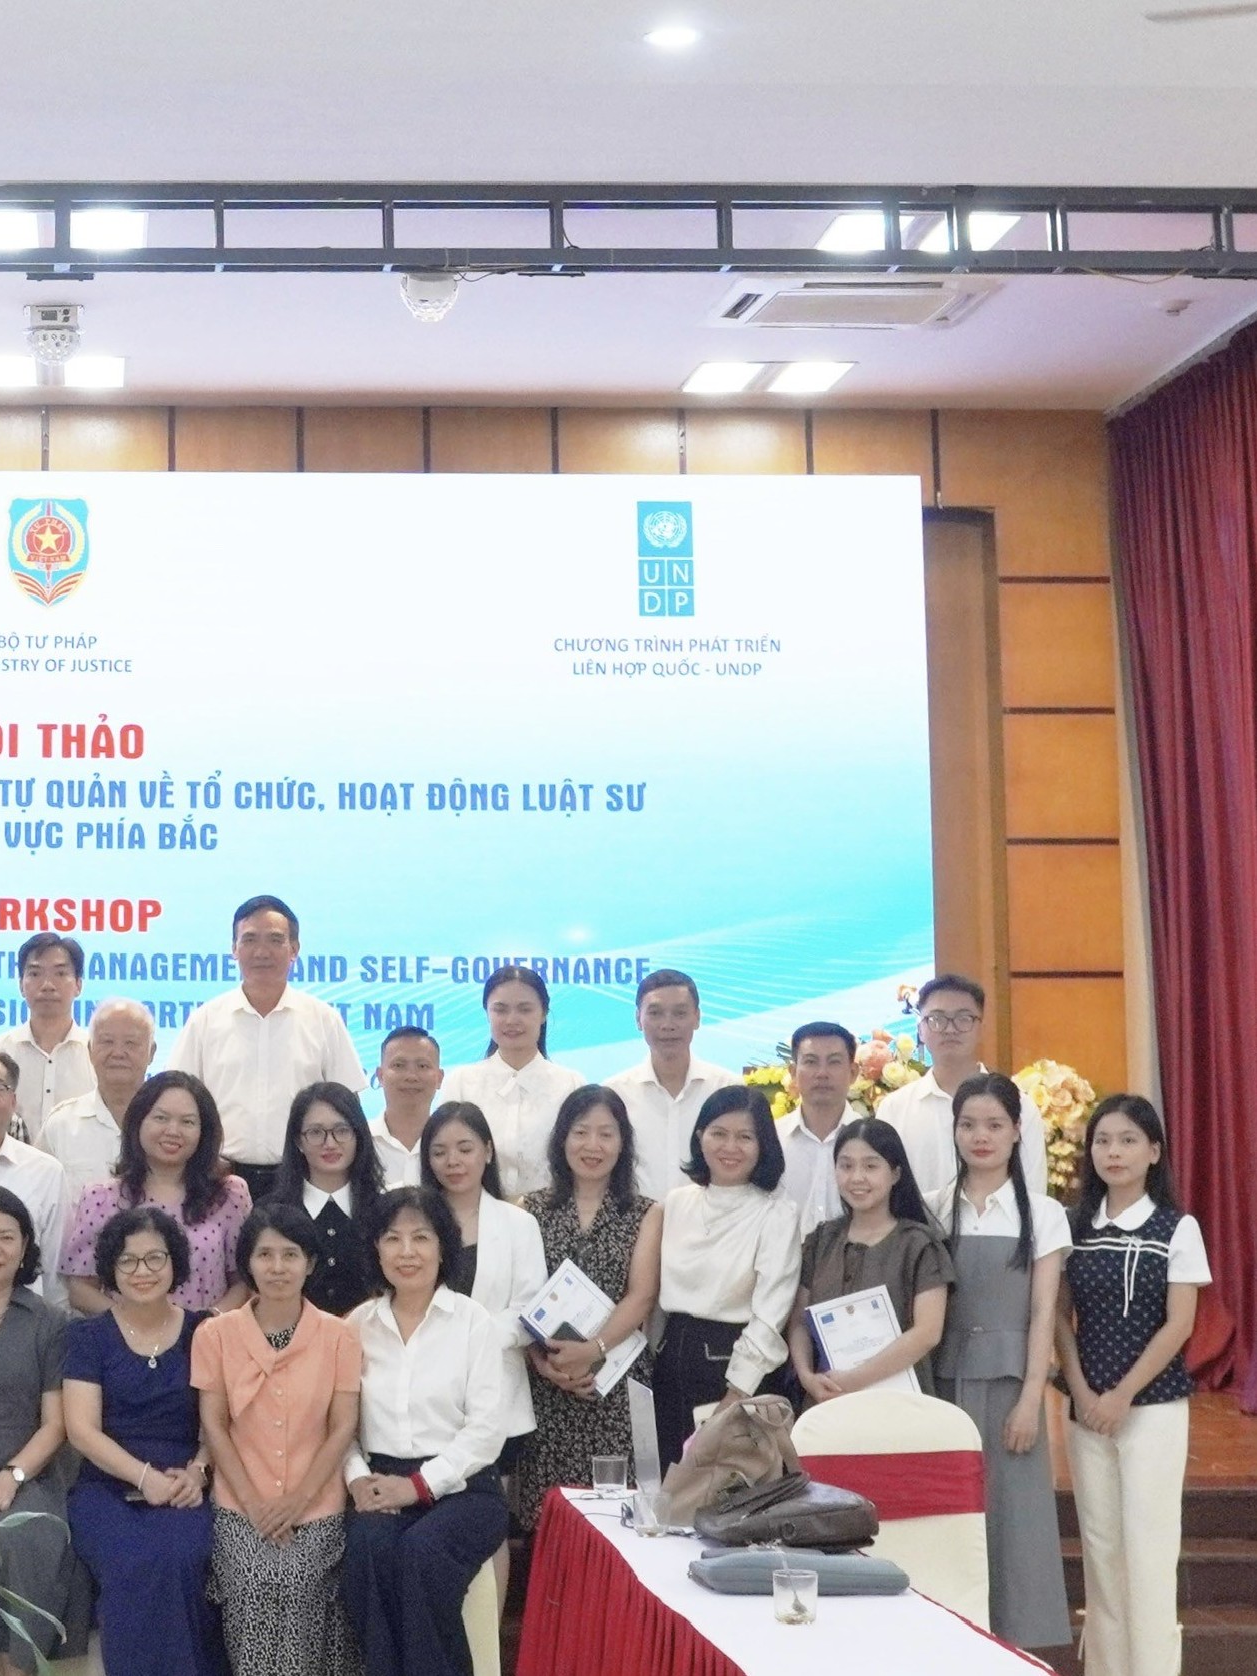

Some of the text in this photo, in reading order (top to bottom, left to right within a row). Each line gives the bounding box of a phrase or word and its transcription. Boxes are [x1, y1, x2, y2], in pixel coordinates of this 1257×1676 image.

[643, 563, 689, 583] UN
[644, 592, 689, 613] DP
[25, 634, 49, 649] TƯ
[54, 632, 98, 650] PHÁP
[553, 633, 781, 653] CHƯƠNG TRÌNH PHÁT TRIỂN
[45, 659, 66, 673] OF
[70, 659, 133, 673] JUSTICE
[573, 658, 607, 676] LIÊN
[613, 661, 647, 678] HỢP
[652, 657, 700, 678] QUỐC
[715, 662, 763, 676] UNDP
[36, 713, 145, 760] THẢO
[46, 772, 127, 809] QUẢN
[139, 770, 175, 809] VỀ
[185, 770, 223, 810] TỔ
[235, 776, 326, 812] CHỨC,
[339, 782, 415, 817] HOẠT
[426, 777, 510, 817] ĐỘNG
[522, 777, 594, 818] LUẬT
[606, 781, 647, 812] SƯ
[4, 819, 64, 856] VỰC
[76, 816, 146, 850] PHÍA
[158, 813, 218, 851] BẮC
[83, 952, 243, 982] ANAGEME
[287, 955, 348, 983] AND
[364, 1003, 435, 1031] NAM
